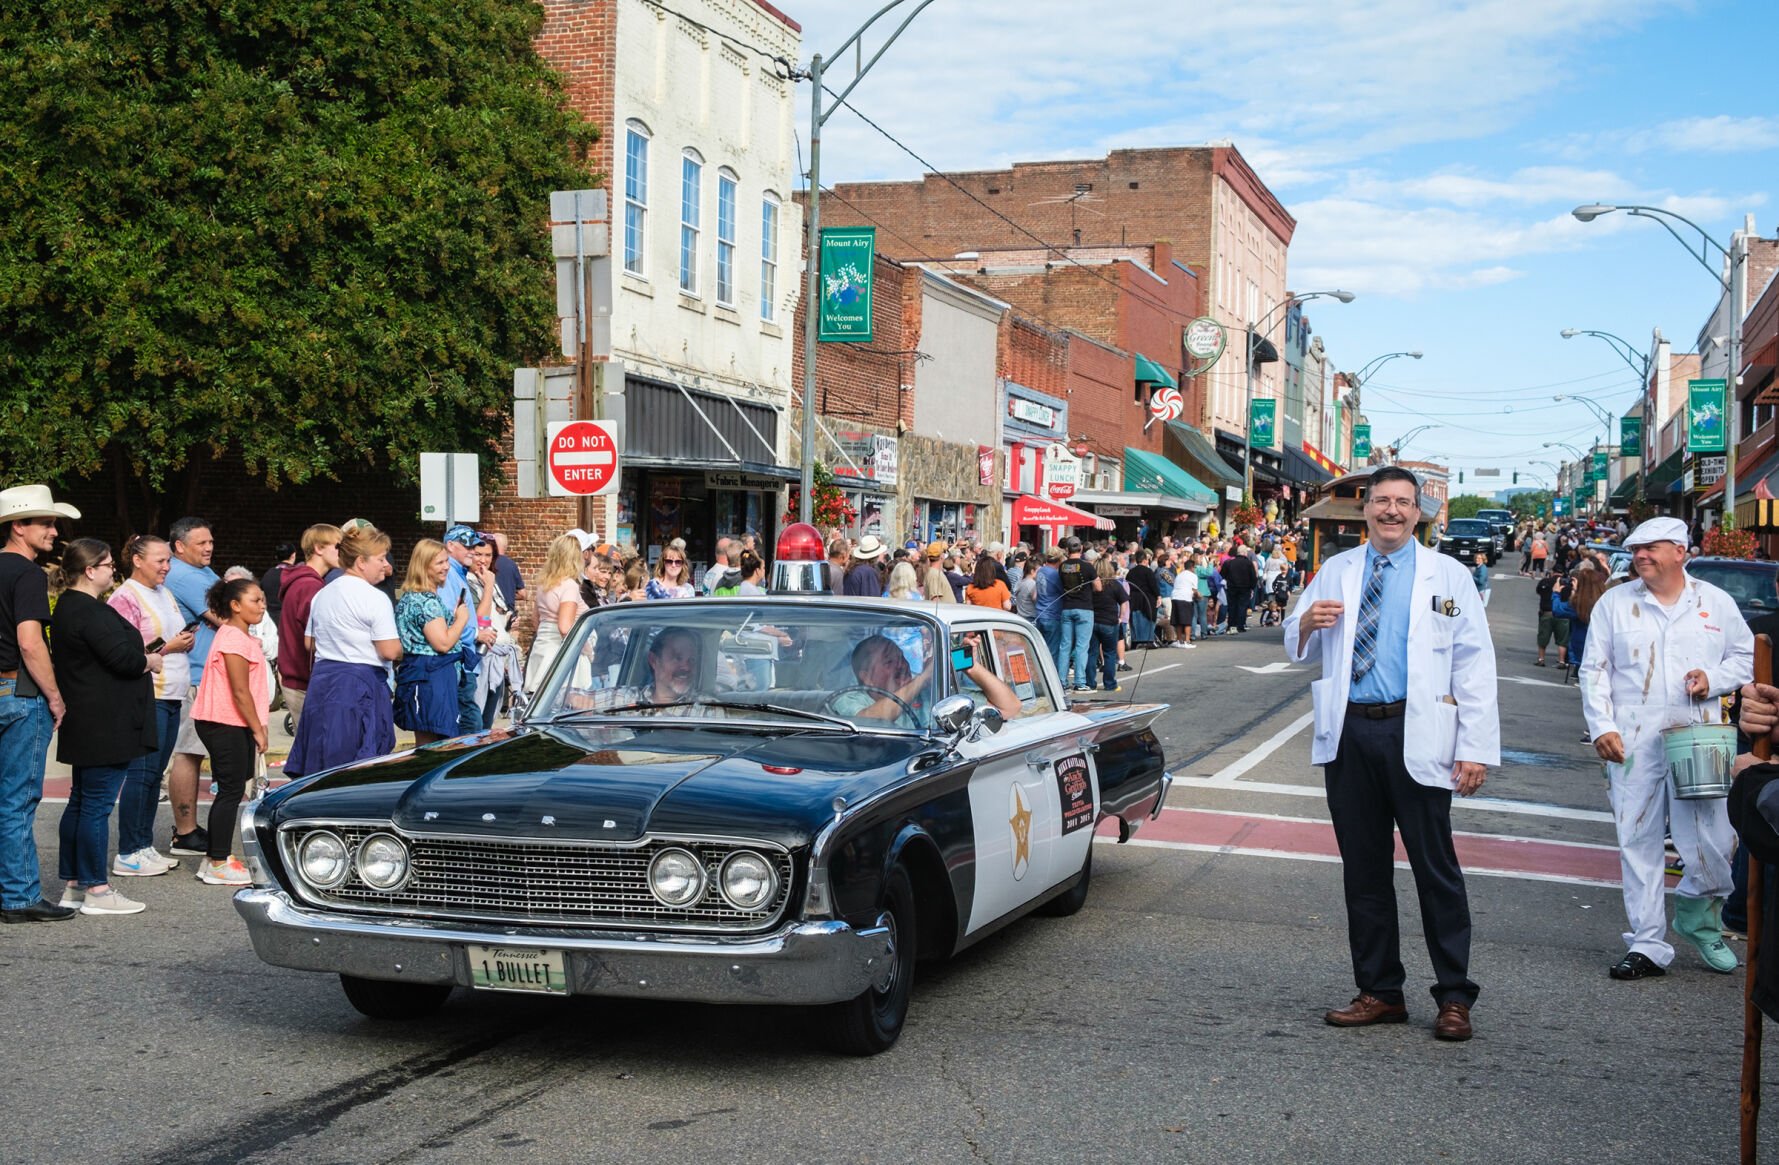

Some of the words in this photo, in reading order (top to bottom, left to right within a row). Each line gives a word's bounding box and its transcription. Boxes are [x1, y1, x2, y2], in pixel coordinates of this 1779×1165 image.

[853, 240, 869, 248] Airy
[558, 436, 575, 448] DO
[582, 436, 606, 448] NOT
[564, 468, 602, 480] ENTER
[1049, 464, 1076, 472] SNAPPY
[716, 474, 738, 486] Fabric
[740, 475, 780, 490] Menagerie
[1050, 474, 1074, 482] LUNCH
[424, 811, 616, 829] FORD
[492, 948, 539, 960] Tennessee
[482, 960, 490, 980] 1
[496, 960, 550, 984] BULLET
